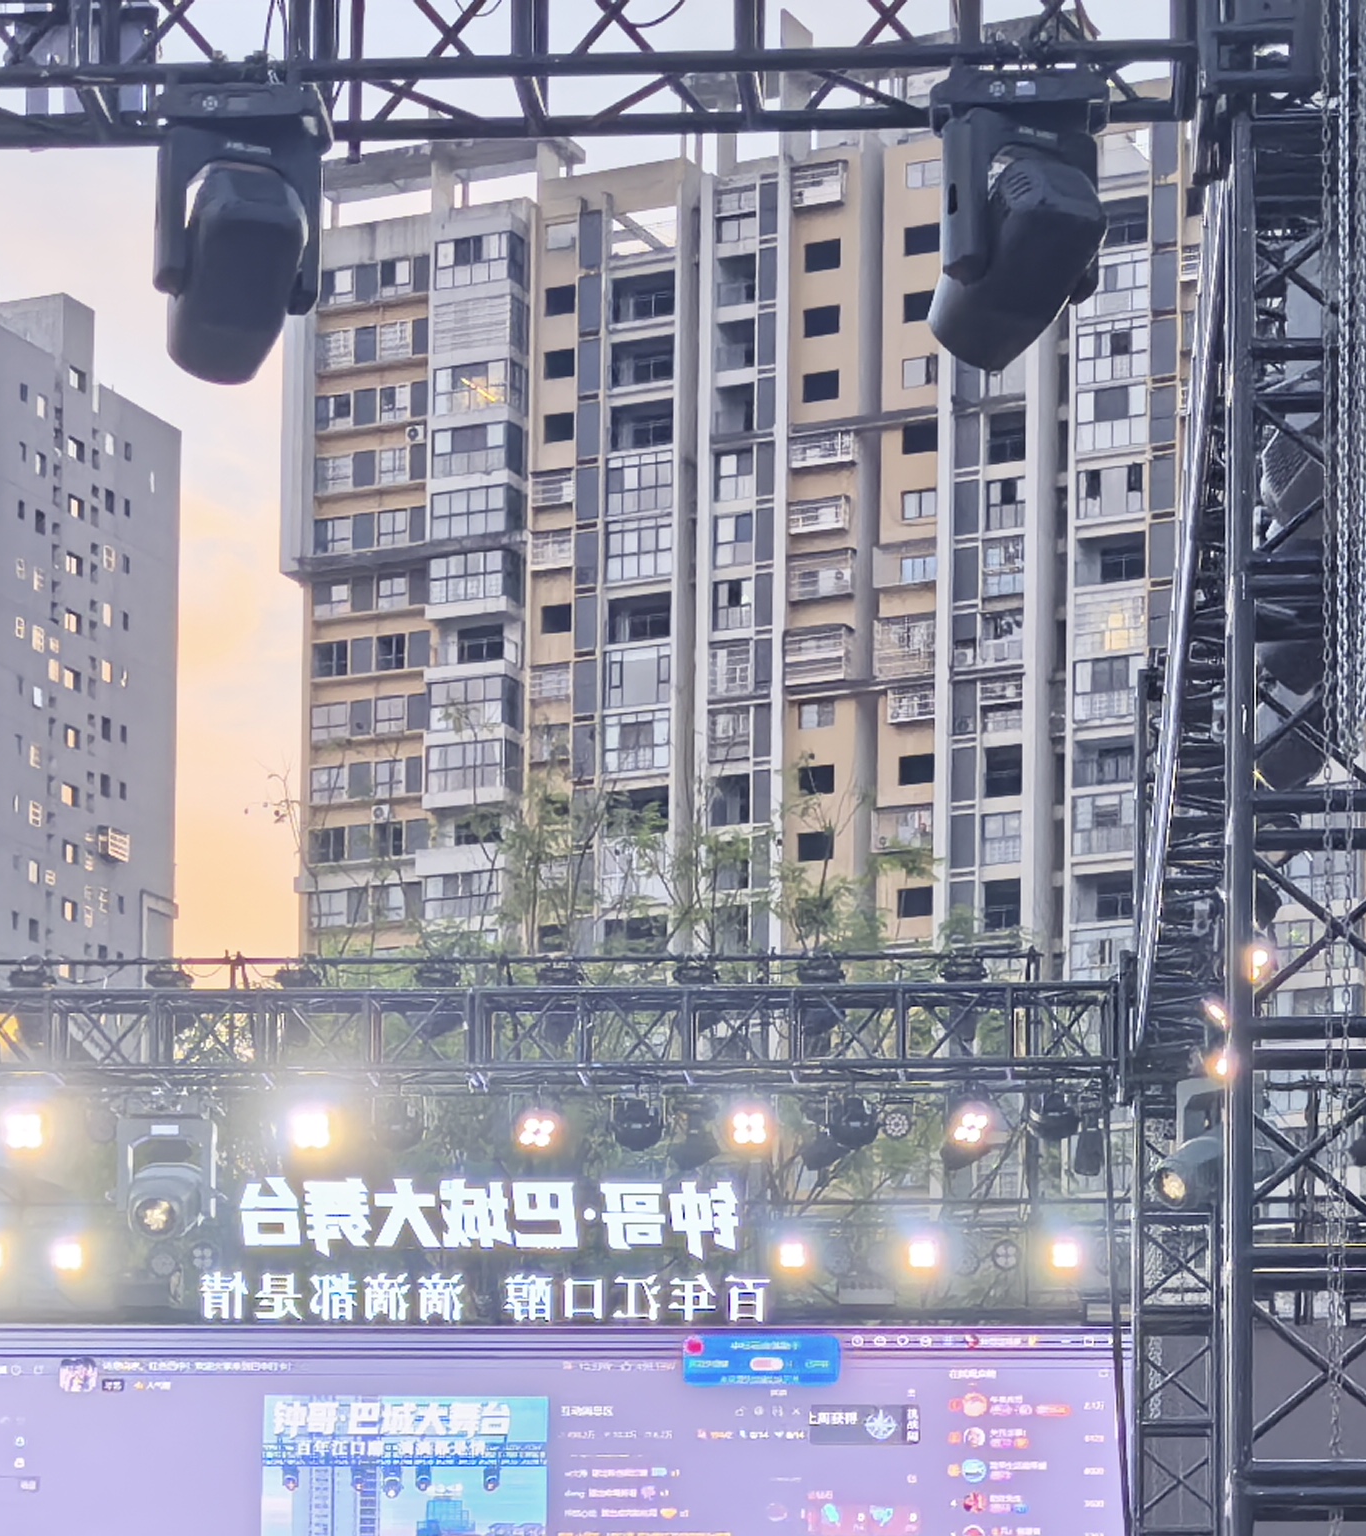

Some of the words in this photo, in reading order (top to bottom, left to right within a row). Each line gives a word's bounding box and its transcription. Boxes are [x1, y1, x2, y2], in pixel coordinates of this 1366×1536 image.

[274, 1401, 510, 1438] 钟哥·巴城大舞台
